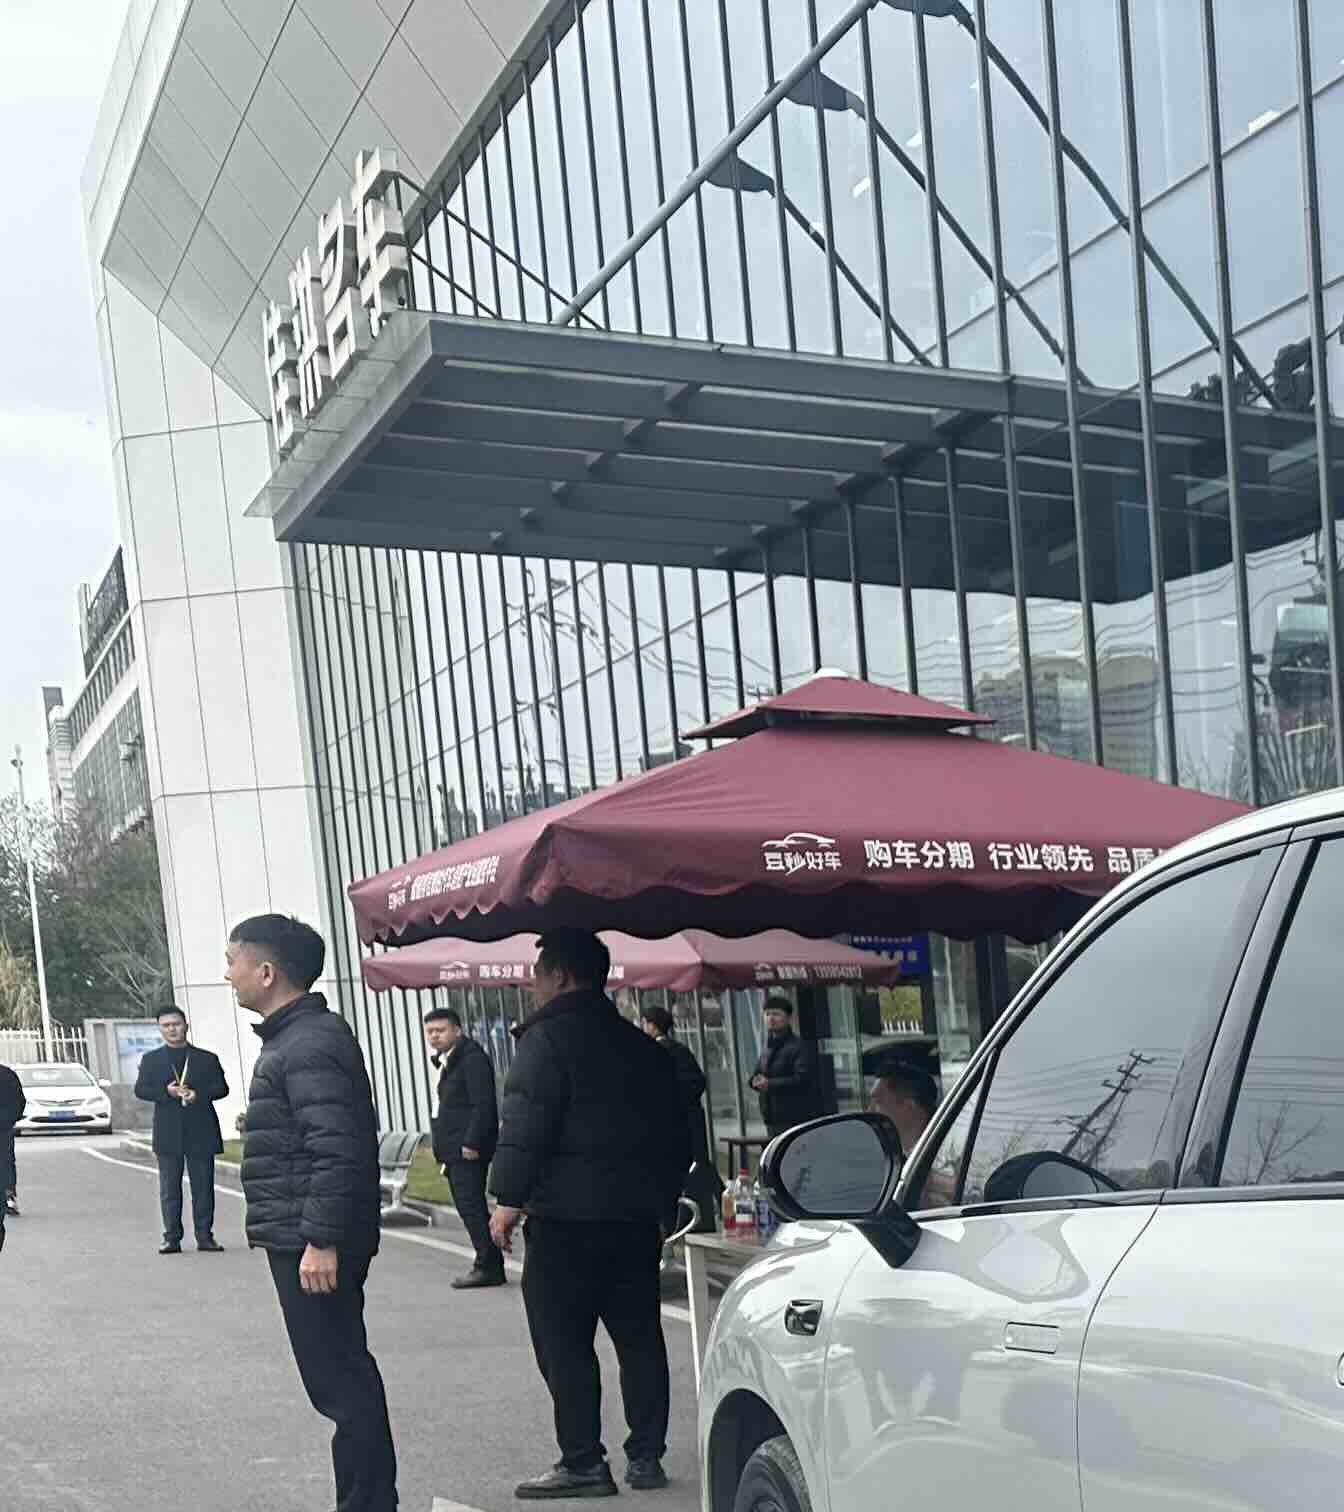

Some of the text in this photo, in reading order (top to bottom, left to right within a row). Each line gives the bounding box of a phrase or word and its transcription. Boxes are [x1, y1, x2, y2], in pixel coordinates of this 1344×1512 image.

[863, 839, 1168, 873] 购车分期 行业领先 品质
